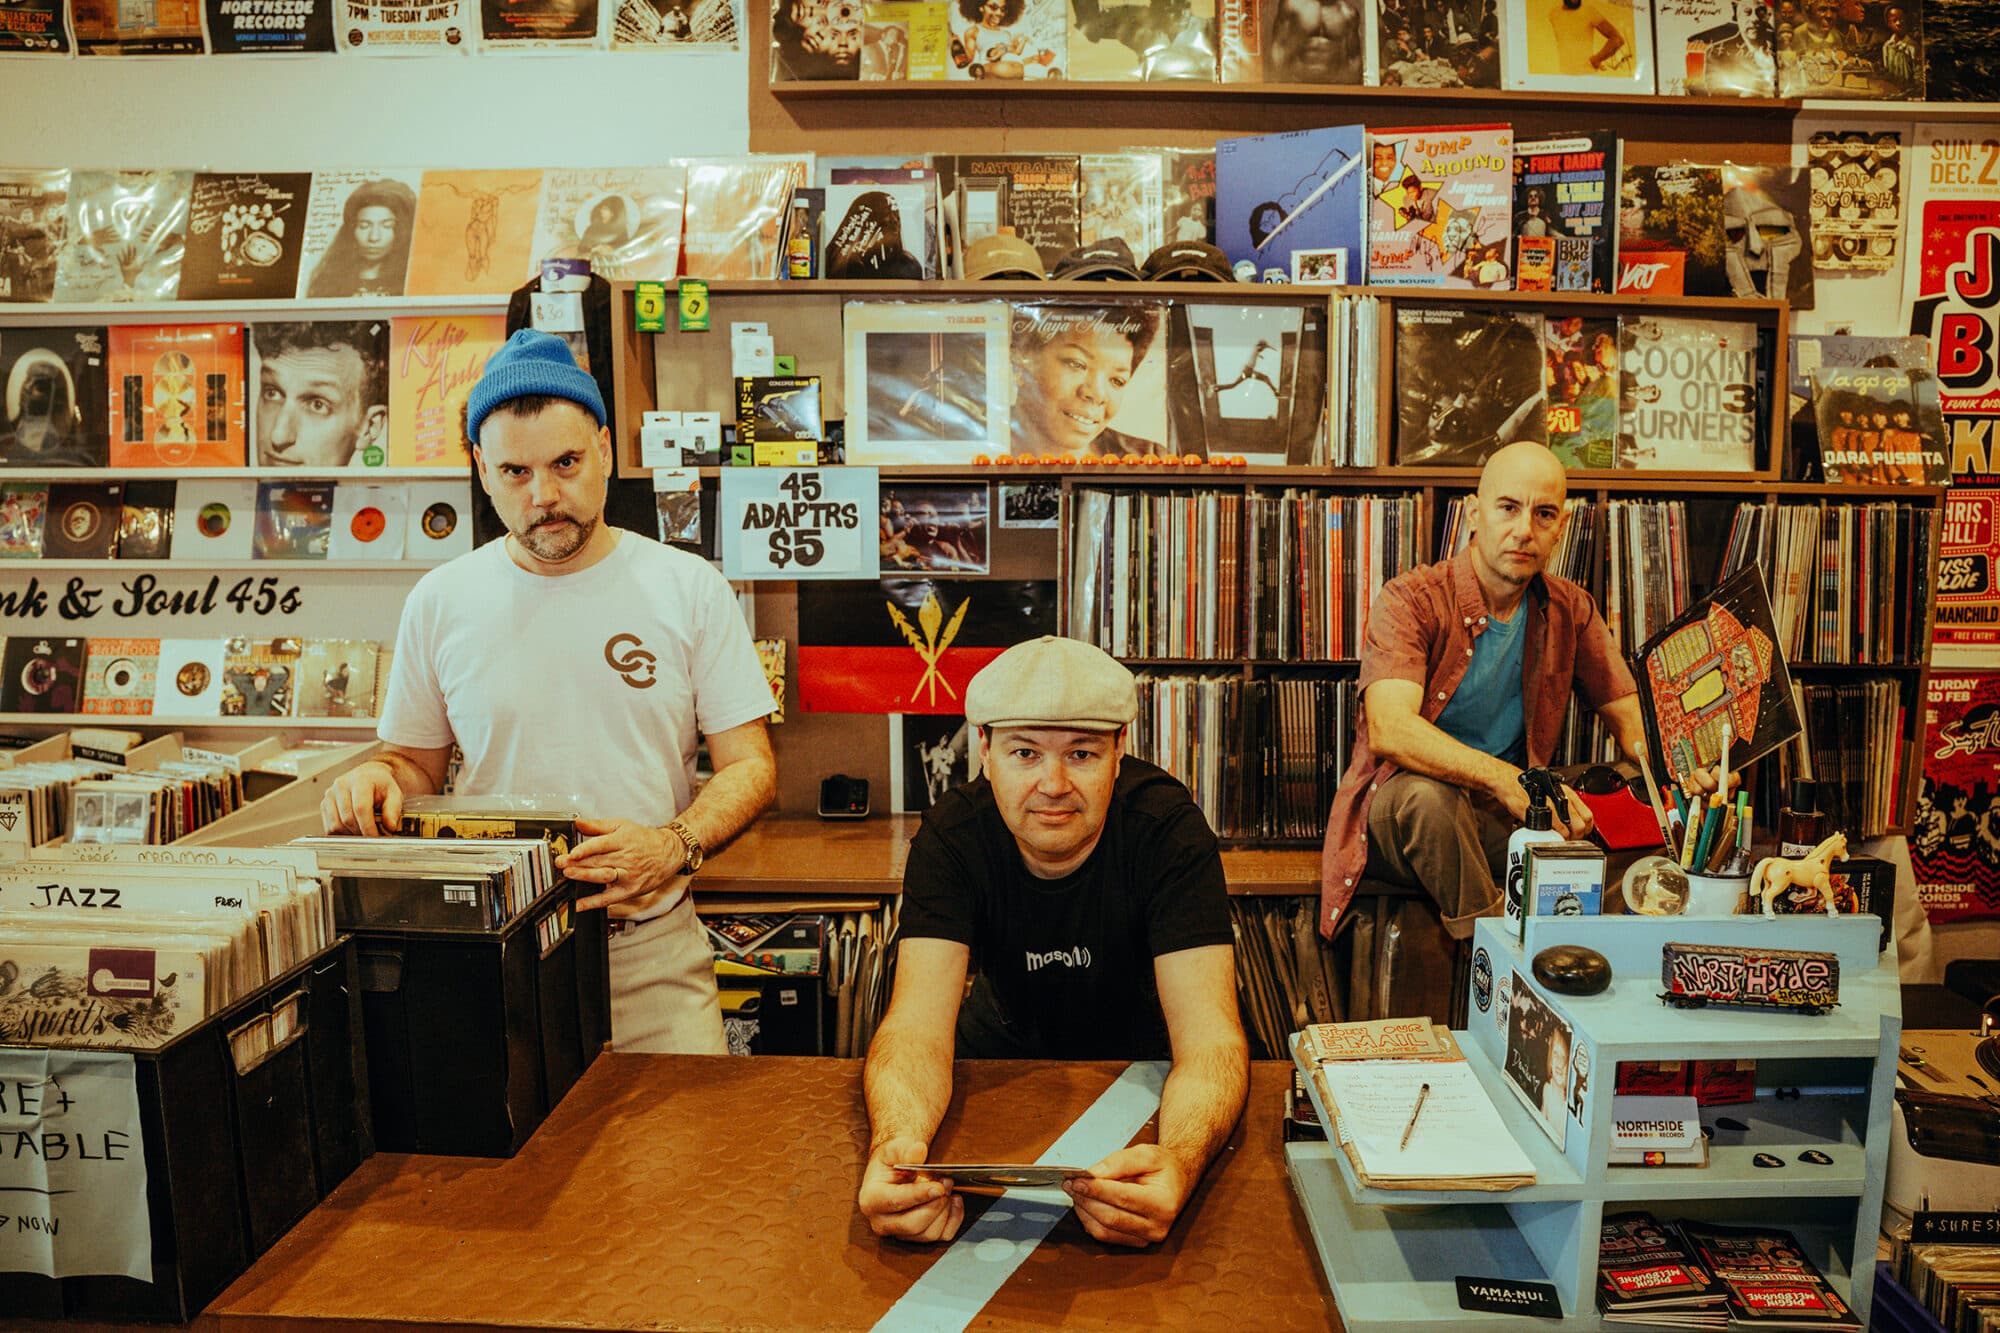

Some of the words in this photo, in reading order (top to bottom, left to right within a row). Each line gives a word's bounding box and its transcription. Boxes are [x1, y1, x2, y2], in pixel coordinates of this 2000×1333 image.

[220, 0, 314, 14] NORTHSIDE
[347, 5, 369, 20] 7PM
[380, 9, 421, 23] TUESDAY
[425, 6, 449, 21] JUNE
[453, 3, 459, 17] 7
[233, 15, 306, 29] RECORDS
[1414, 136, 1472, 158] JUMP
[1931, 139, 1977, 161] SUN.
[971, 161, 1076, 174] NATURALLY
[1420, 153, 1505, 177] AROUND
[1530, 155, 1562, 173] FUNK
[1563, 152, 1605, 171] DADDY
[1833, 172, 1871, 188] HOP
[1930, 162, 1975, 185] DEC.
[1448, 181, 1494, 194] James
[1463, 194, 1508, 206] Brown
[1812, 190, 1895, 209] SCOTCH
[1560, 240, 1590, 250] RUN
[1371, 249, 1415, 266] JUMP
[1012, 309, 1072, 344] Maya
[1075, 311, 1142, 334] Angelou
[401, 320, 469, 378] Kylie
[1620, 347, 1755, 381] COOKIN'
[1680, 380, 1721, 411] on
[1722, 384, 1756, 414] 3
[1946, 399, 1979, 409] FUNK
[1981, 398, 2000, 409] DIS
[1620, 409, 1755, 443] BURNERS
[1825, 451, 1871, 465] DARA
[779, 472, 823, 501] 45
[741, 502, 860, 531] ADAPTRS
[1944, 501, 1988, 524] HRIS.
[768, 528, 825, 569] $5
[58, 577, 103, 620] &
[113, 573, 220, 616] Soul
[226, 576, 303, 615] 45s
[1936, 606, 1998, 623] MANCHILD
[1953, 630, 1970, 640] FREE
[1927, 679, 1979, 690] TURDAY
[1926, 691, 1943, 702] RD
[1945, 691, 1971, 702] FEB
[29, 884, 122, 909] JAZZ
[215, 895, 244, 909] FRESH
[1918, 884, 1976, 893] RTHSIDE
[1918, 893, 1961, 903] CORDS
[1320, 1033, 1429, 1050] EMAIL
[1616, 1120, 1684, 1132] NORTHSIDE
[18, 1215, 60, 1236] NOW
[1468, 1285, 1545, 1302] YAMA-NUI
